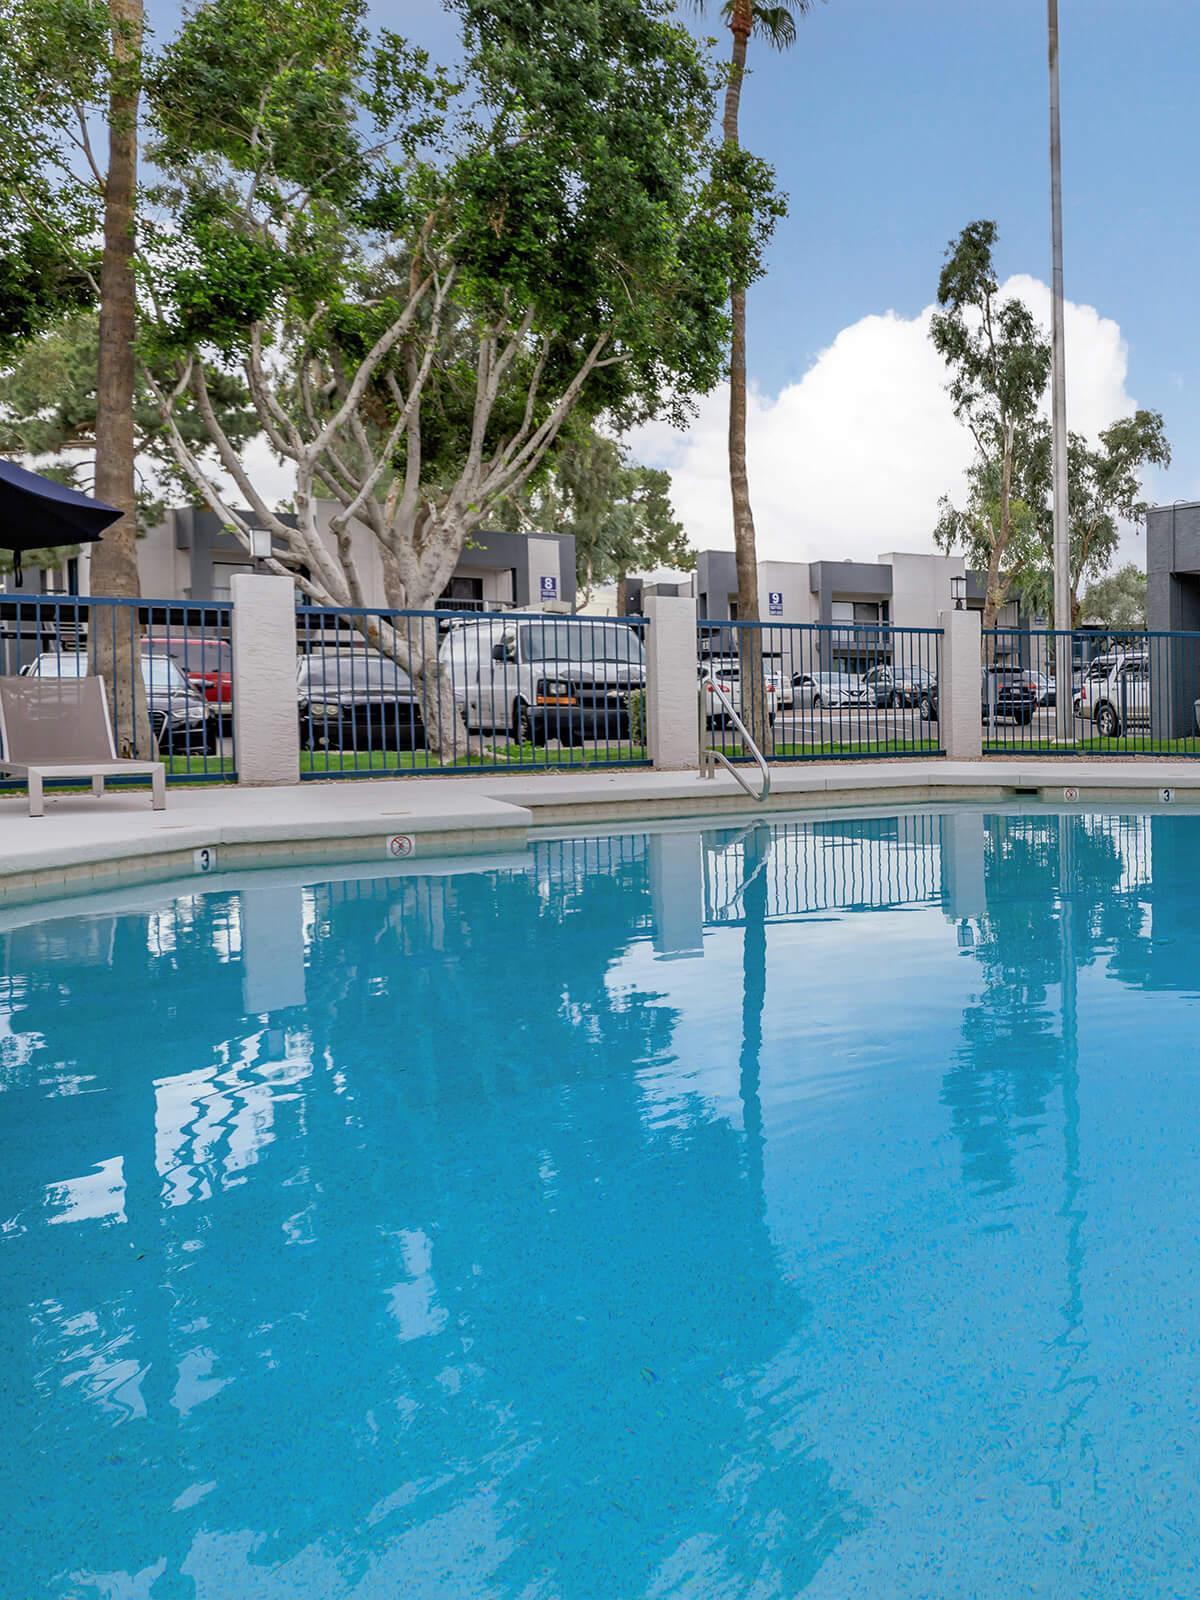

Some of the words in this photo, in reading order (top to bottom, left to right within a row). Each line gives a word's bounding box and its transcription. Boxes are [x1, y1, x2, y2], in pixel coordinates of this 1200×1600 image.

[544, 577, 553, 589] 8
[772, 593, 780, 604] 9
[1163, 789, 1170, 801] 3
[201, 849, 209, 871] 3
